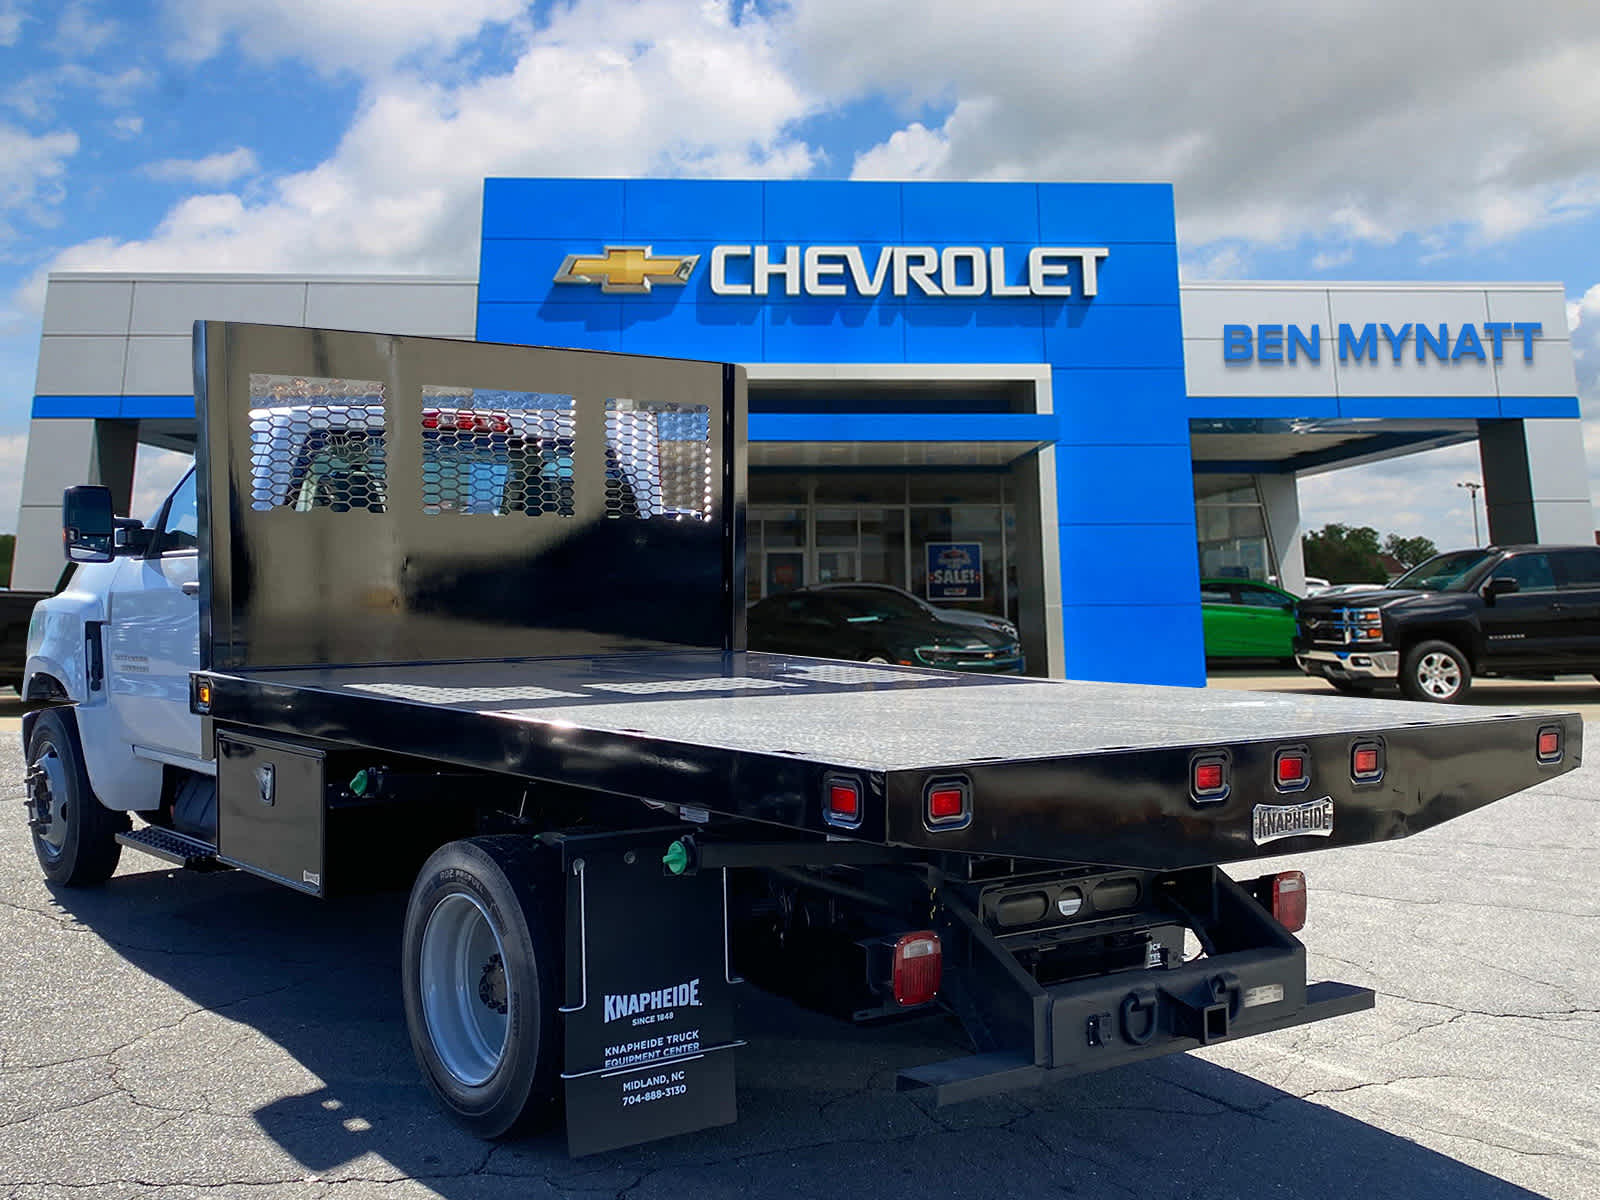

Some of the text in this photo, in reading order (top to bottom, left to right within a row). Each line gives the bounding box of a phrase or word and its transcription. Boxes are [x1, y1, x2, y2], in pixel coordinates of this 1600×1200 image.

[710, 245, 1110, 297] CHEVROLET
[1223, 322, 1543, 363] BEN MYNATT
[934, 569, 975, 584] SALE!
[1257, 803, 1332, 839] KNAPHEIDE
[603, 978, 701, 1024] KNAPHEIDE
[632, 1011, 674, 1026] SINCE 1848
[604, 1029, 700, 1057] KNAPHEIDE TRUCK
[604, 1042, 700, 1069] EQUIPMENT CENTER
[623, 1070, 685, 1092] MIDLAND, NC
[622, 1084, 687, 1106] 704-888-3130
